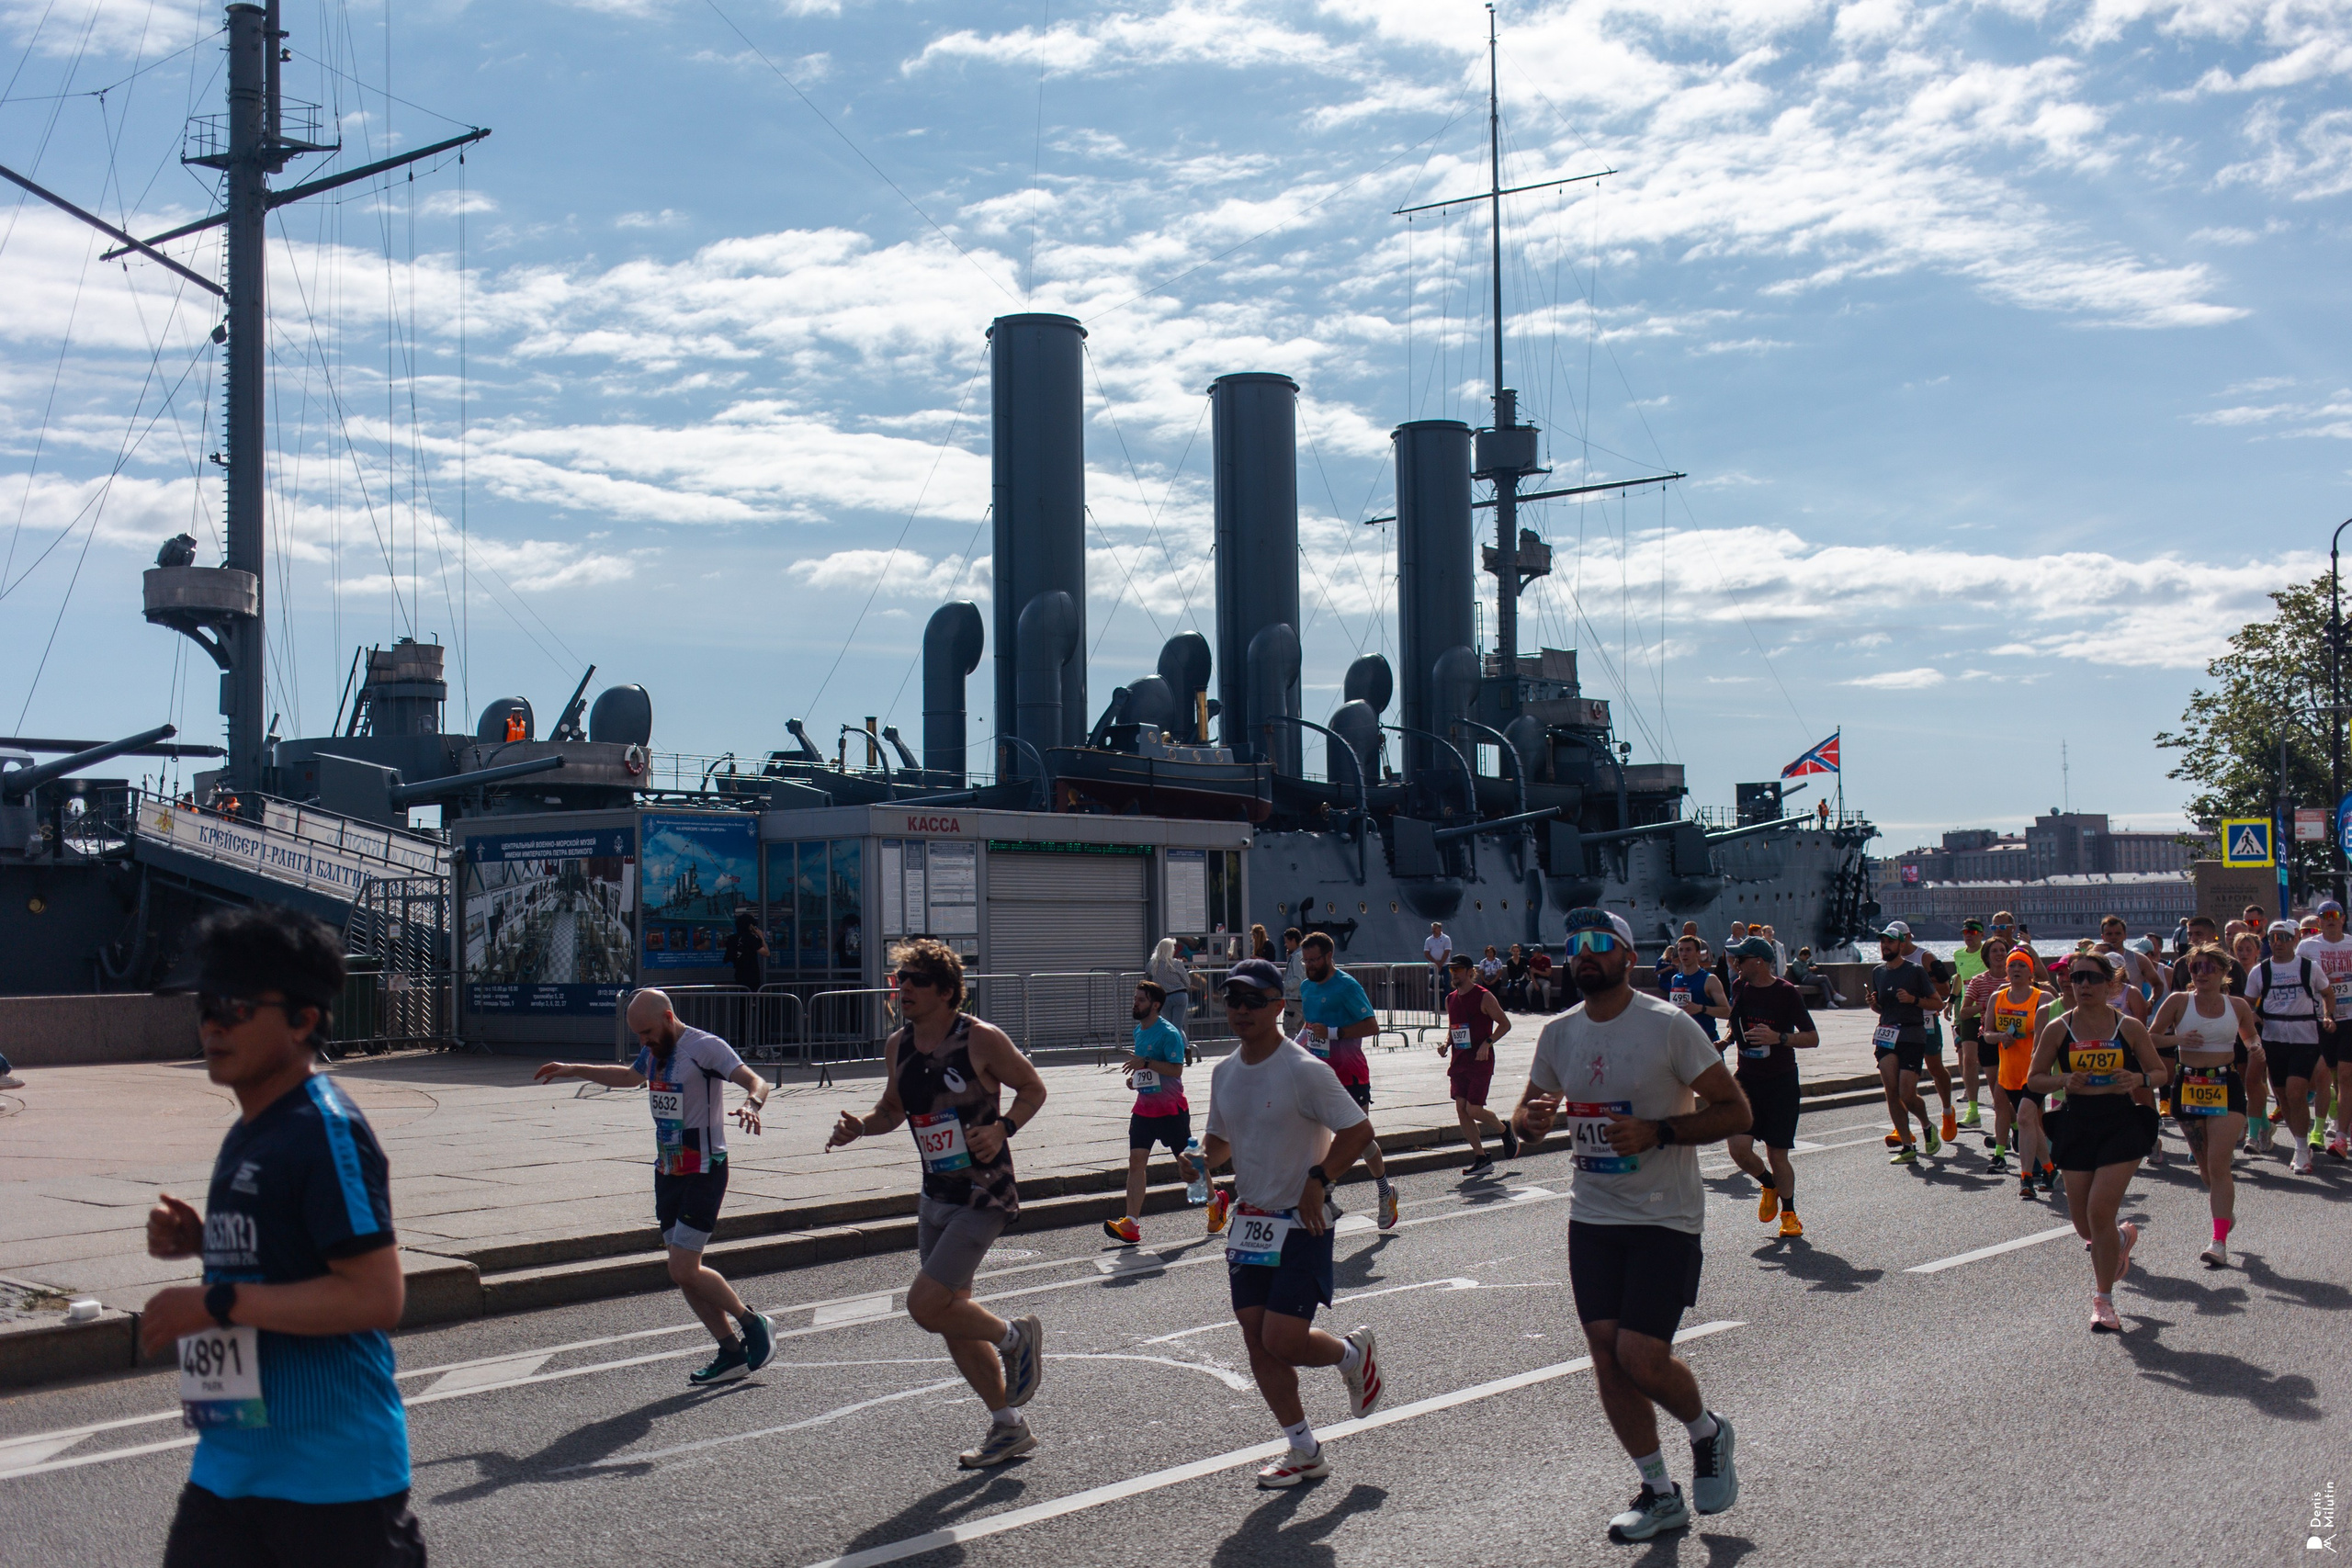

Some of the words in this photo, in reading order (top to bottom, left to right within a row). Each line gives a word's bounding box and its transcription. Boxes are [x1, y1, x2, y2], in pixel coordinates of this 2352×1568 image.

[908, 817, 960, 832] КАССА
[198, 826, 259, 857] КРЕЙСЕР
[501, 840, 535, 851] ЦЕНТРАЛЬНЫЙ
[536, 839, 579, 848] ВОЕННО-МОРСКОЙ
[580, 837, 596, 846] МУЗЕЙ
[522, 850, 552, 858] ИМПЕРАТОРА
[568, 848, 593, 856] ВЕЛИКОГО
[1998, 1016, 2022, 1028] 3508
[1878, 1029, 1894, 1038] 1331
[2076, 1053, 2117, 1068] 4787
[1137, 1071, 1152, 1082] 790
[2188, 1087, 2222, 1100] 1054
[652, 1095, 677, 1111] 5632
[2186, 1105, 2191, 1113] E
[1244, 1221, 1273, 1242] 786
[1239, 1241, 1272, 1249] АЛЕКСАНДР
[184, 1337, 243, 1377] 4891
[202, 1382, 224, 1392] PARK
